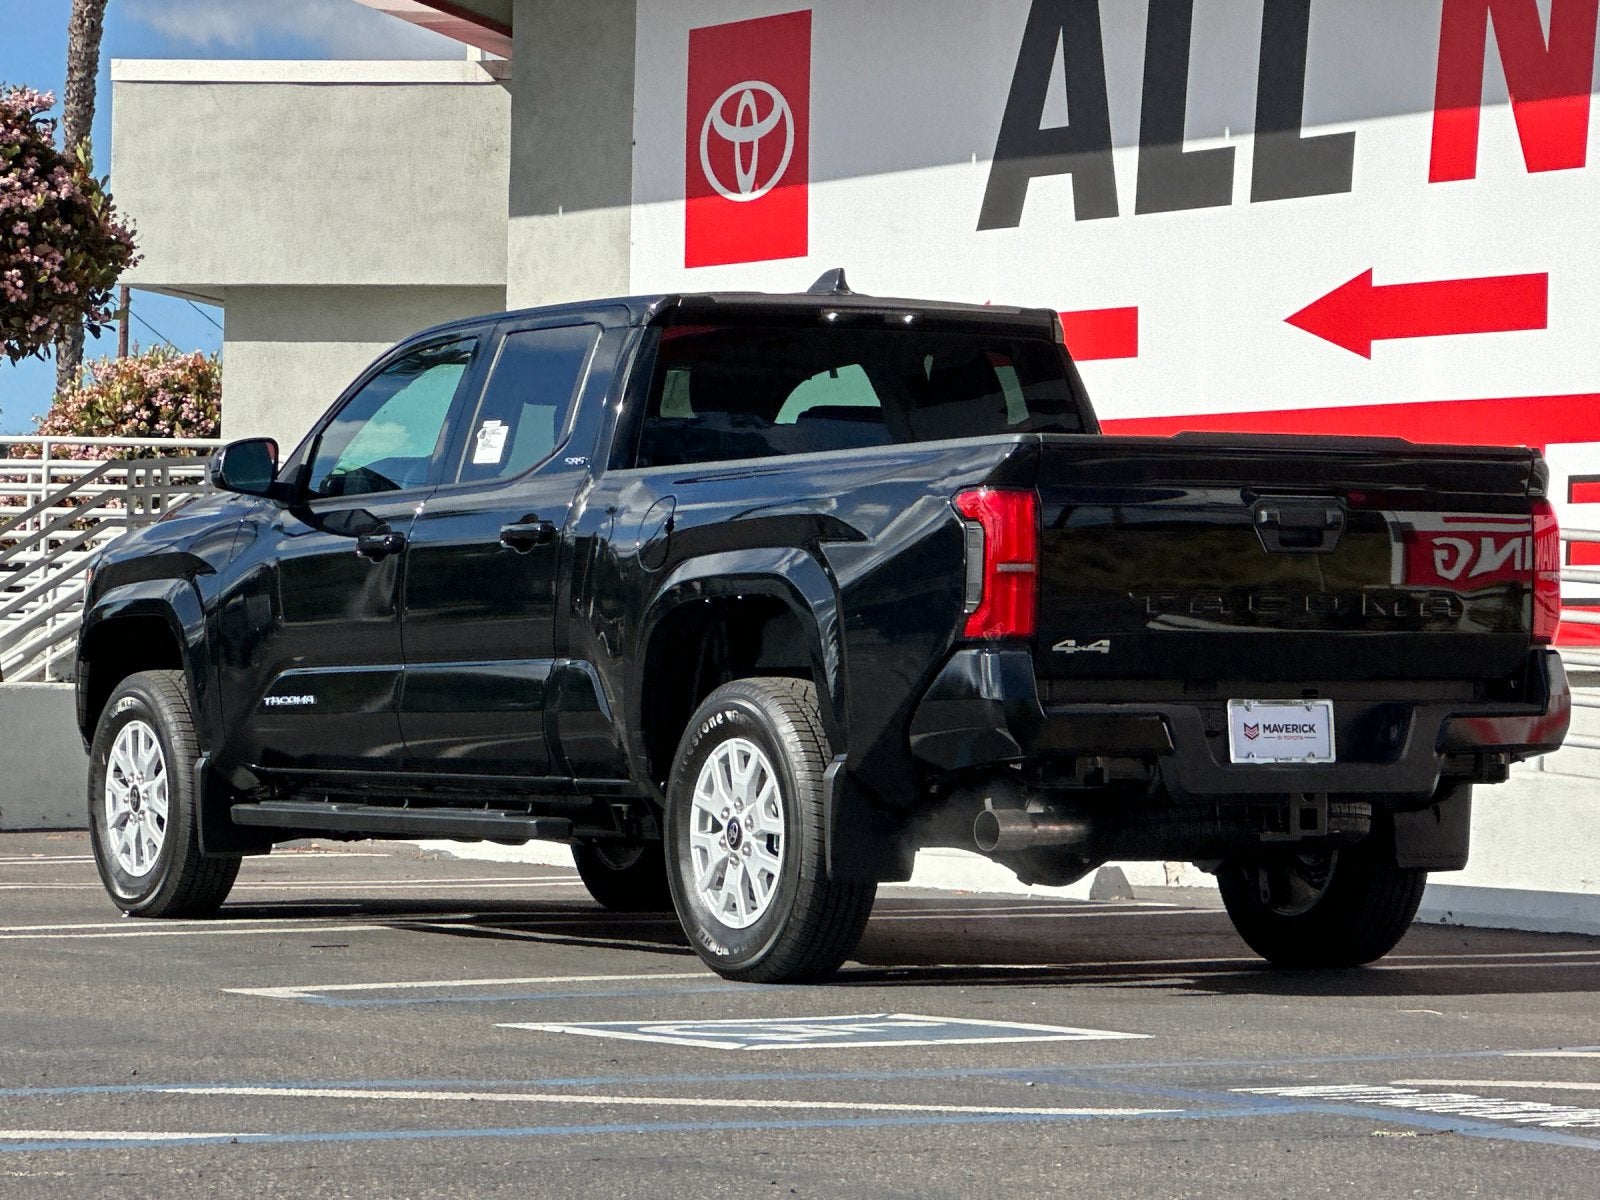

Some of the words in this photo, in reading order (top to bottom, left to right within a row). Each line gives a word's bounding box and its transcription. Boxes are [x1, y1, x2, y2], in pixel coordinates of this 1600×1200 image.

[976, 0, 1356, 231] ALL
[564, 456, 585, 465] SR5
[1130, 588, 1463, 617] TACOMA
[263, 694, 318, 706] TACOMA
[1262, 723, 1317, 734] MAVERICK
